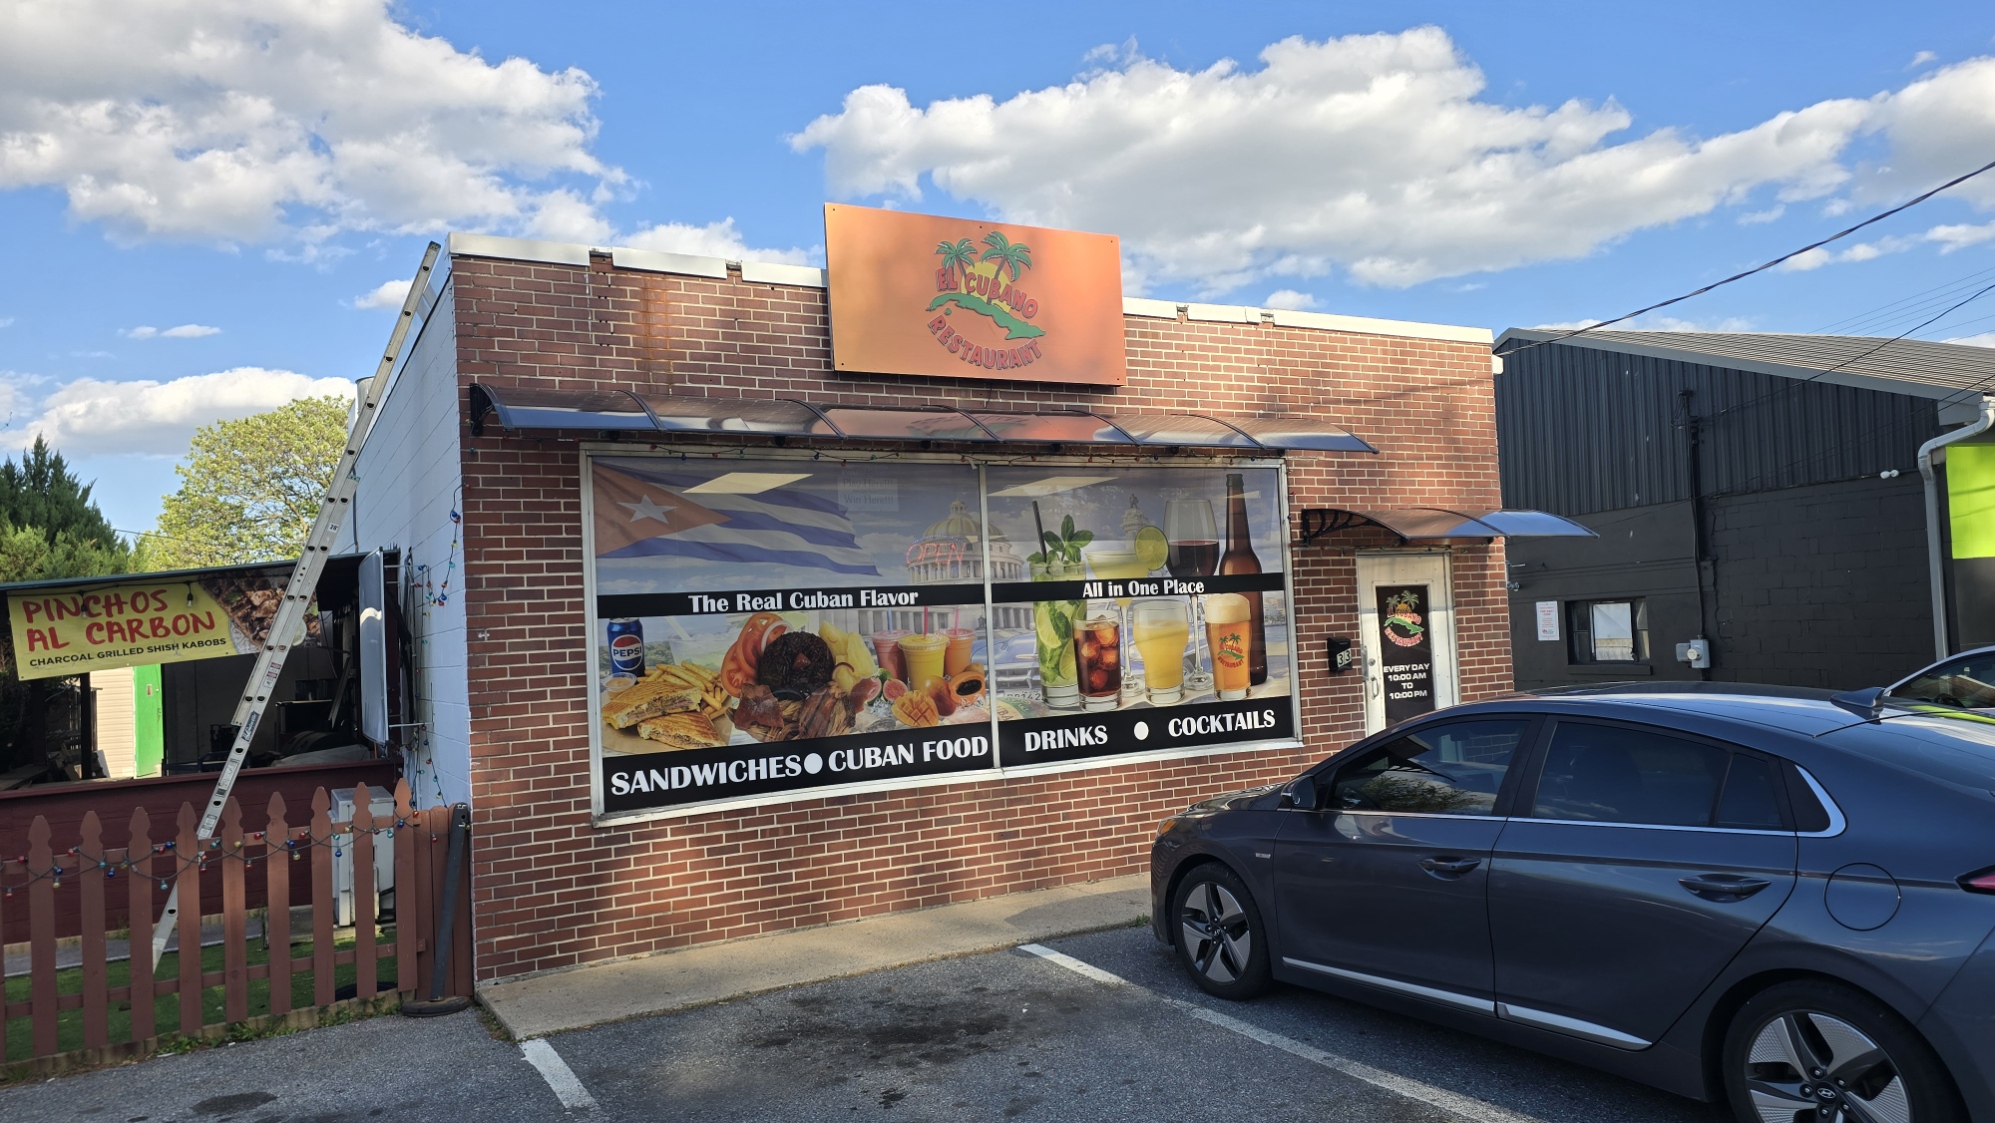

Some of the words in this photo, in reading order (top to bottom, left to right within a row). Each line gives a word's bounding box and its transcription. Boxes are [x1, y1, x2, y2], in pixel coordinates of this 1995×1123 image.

[936, 267, 958, 291] EL
[965, 272, 1038, 319] CUBANO
[928, 314, 1042, 370] RESTAURANT
[906, 543, 966, 565] OPEN
[688, 594, 729, 613] The
[737, 592, 783, 611] Real
[789, 590, 854, 609] Cuban
[860, 588, 919, 607] Flavor
[1083, 580, 1103, 598] All
[1108, 581, 1123, 596] in
[1129, 580, 1159, 595] One
[1164, 579, 1205, 593] Place
[22, 589, 169, 624] PINCHOS
[26, 626, 71, 652] AL
[85, 610, 216, 645] CARBON
[29, 654, 94, 667] CHARCOAL
[97, 646, 145, 659] GRILLED
[147, 642, 180, 654] SHISH
[182, 638, 227, 650] KABOBS
[612, 647, 643, 657] PEPSI
[1338, 650, 1351, 665] 33
[1388, 673, 1412, 682] 10:00
[1412, 672, 1427, 680] AM
[1411, 663, 1430, 671] DAY
[1389, 690, 1414, 700] 10:00
[1025, 725, 1108, 752] DRINKS
[1168, 710, 1276, 737] COCKTAILS
[610, 755, 801, 796] SANDWICHES
[828, 743, 914, 772] CUBAN
[923, 736, 989, 762] FOOD
